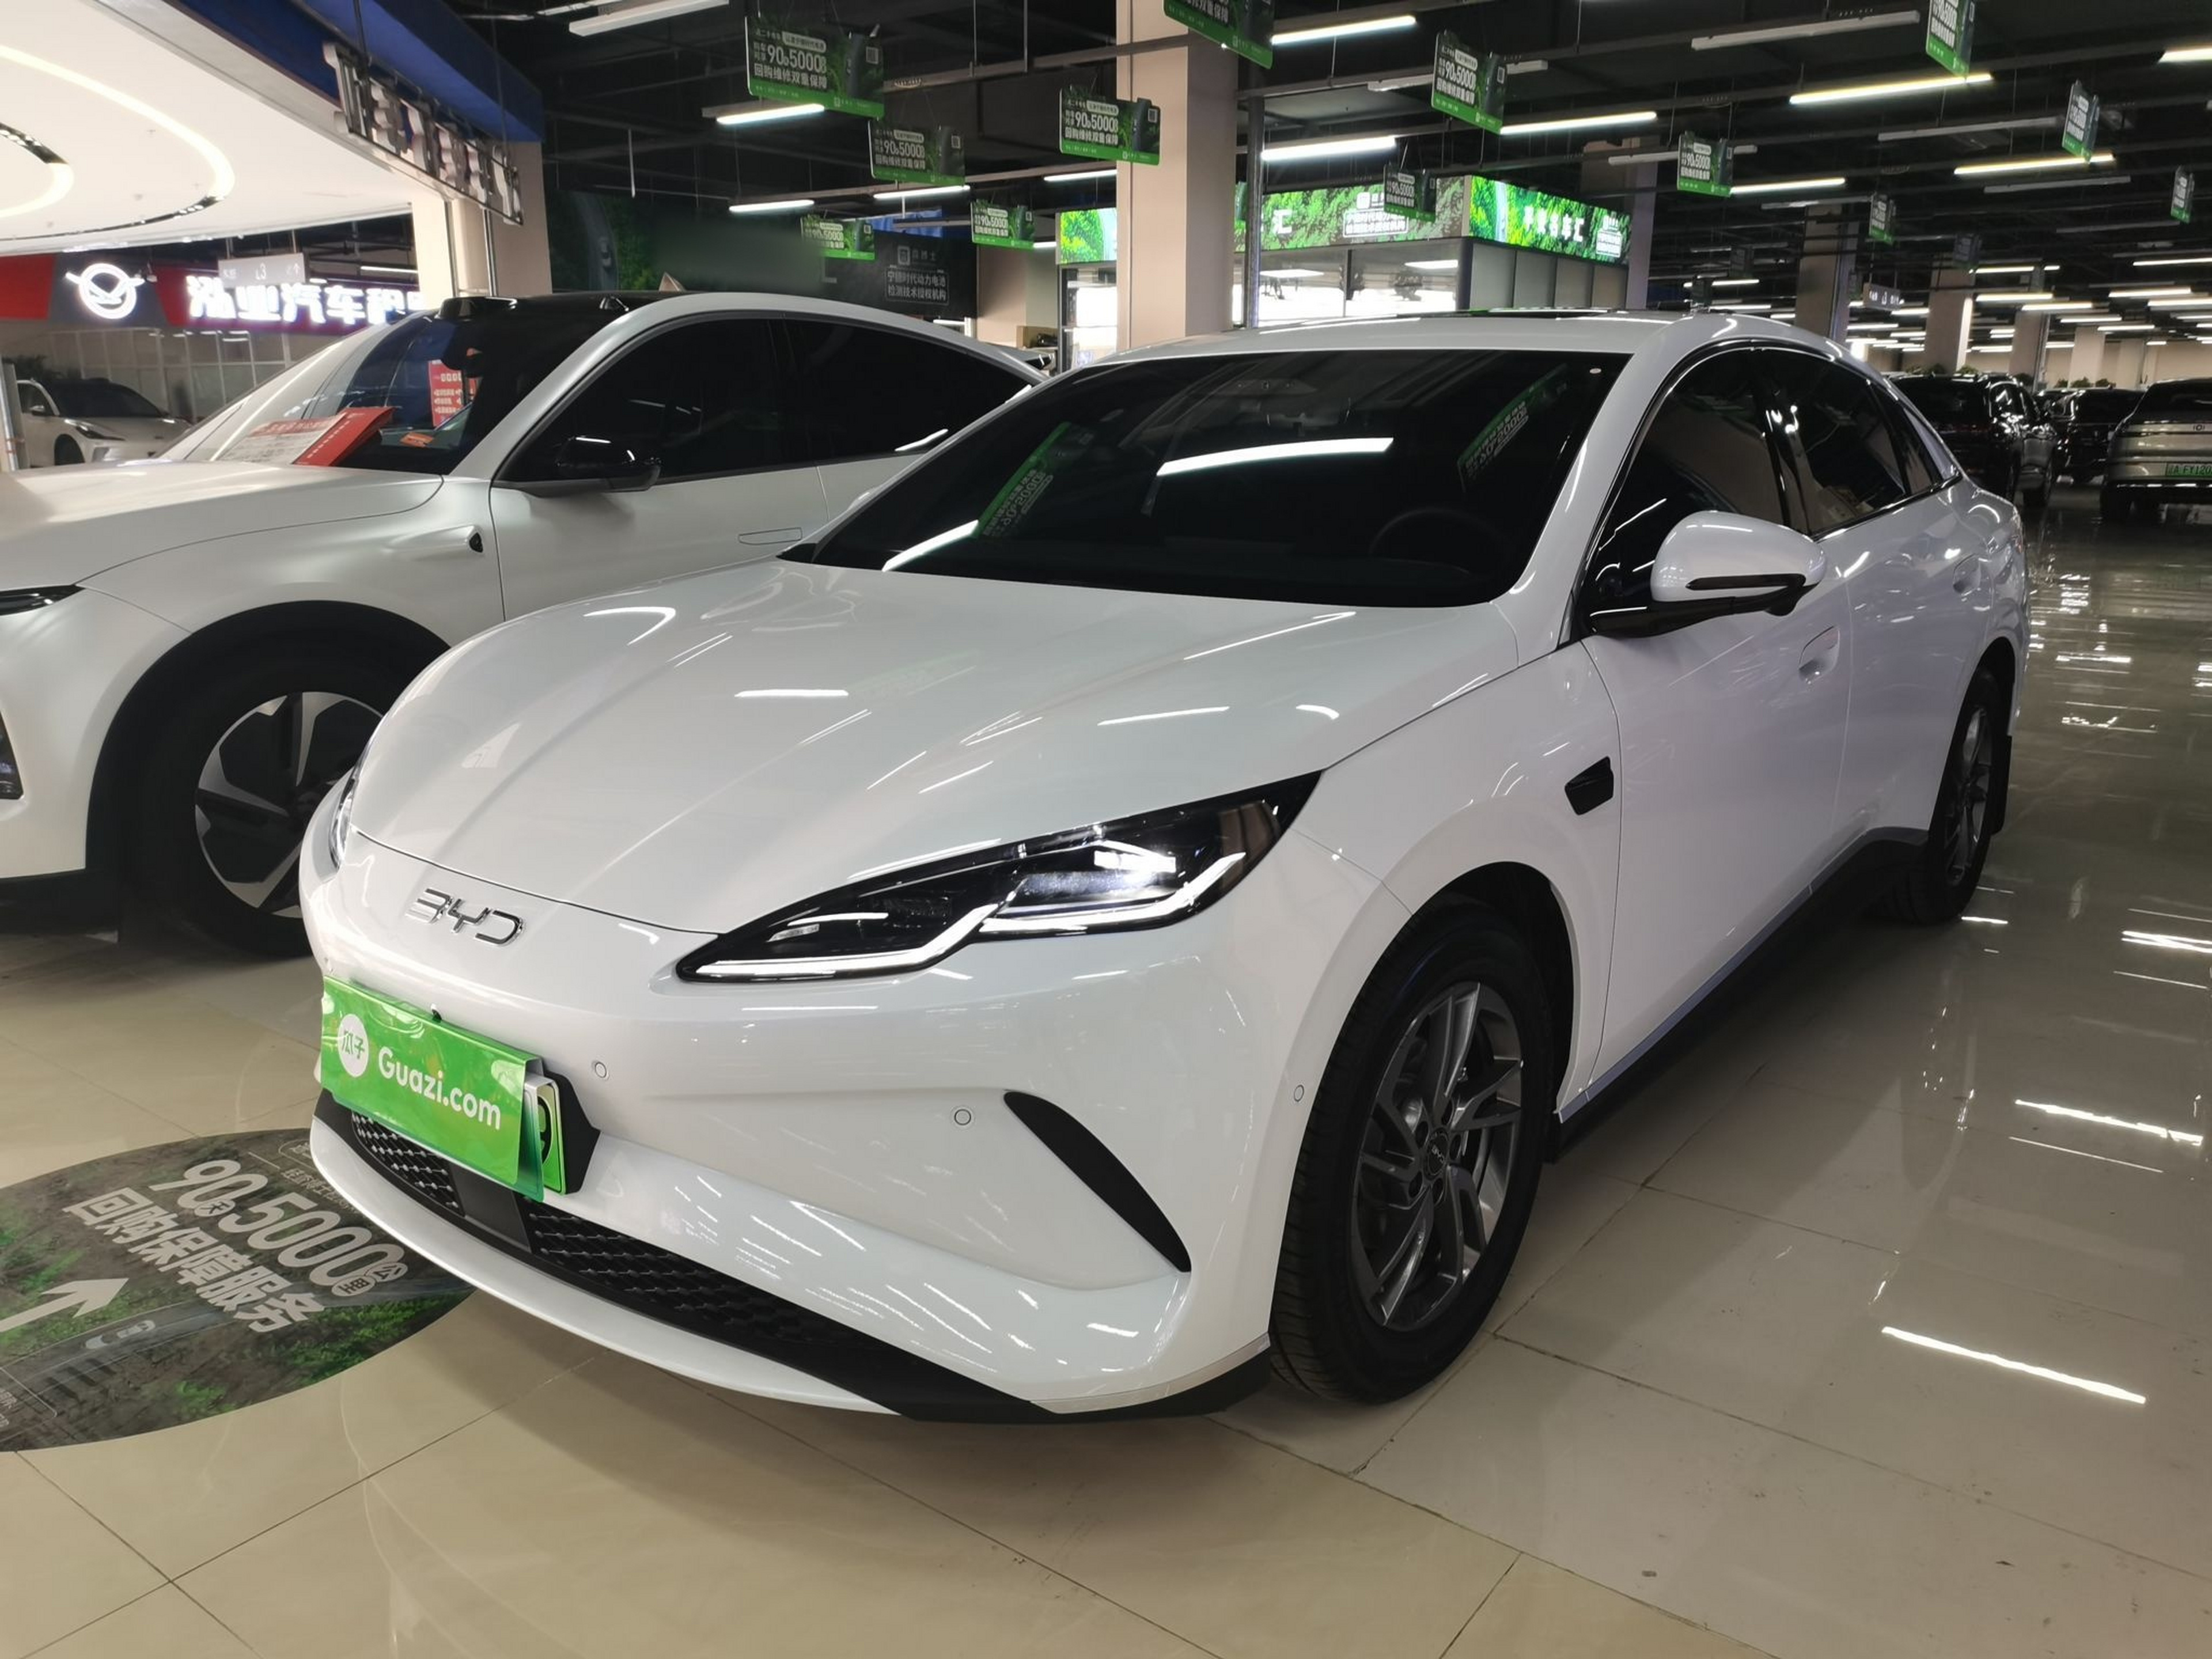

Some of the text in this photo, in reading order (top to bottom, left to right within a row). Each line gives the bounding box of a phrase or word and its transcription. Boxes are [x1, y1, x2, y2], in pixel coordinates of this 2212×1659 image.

[406, 888, 525, 946] BYD
[340, 1029, 365, 1061] 瓜子
[378, 1046, 502, 1131] Guazi.com
[62, 1187, 325, 1333] 回购保障服务
